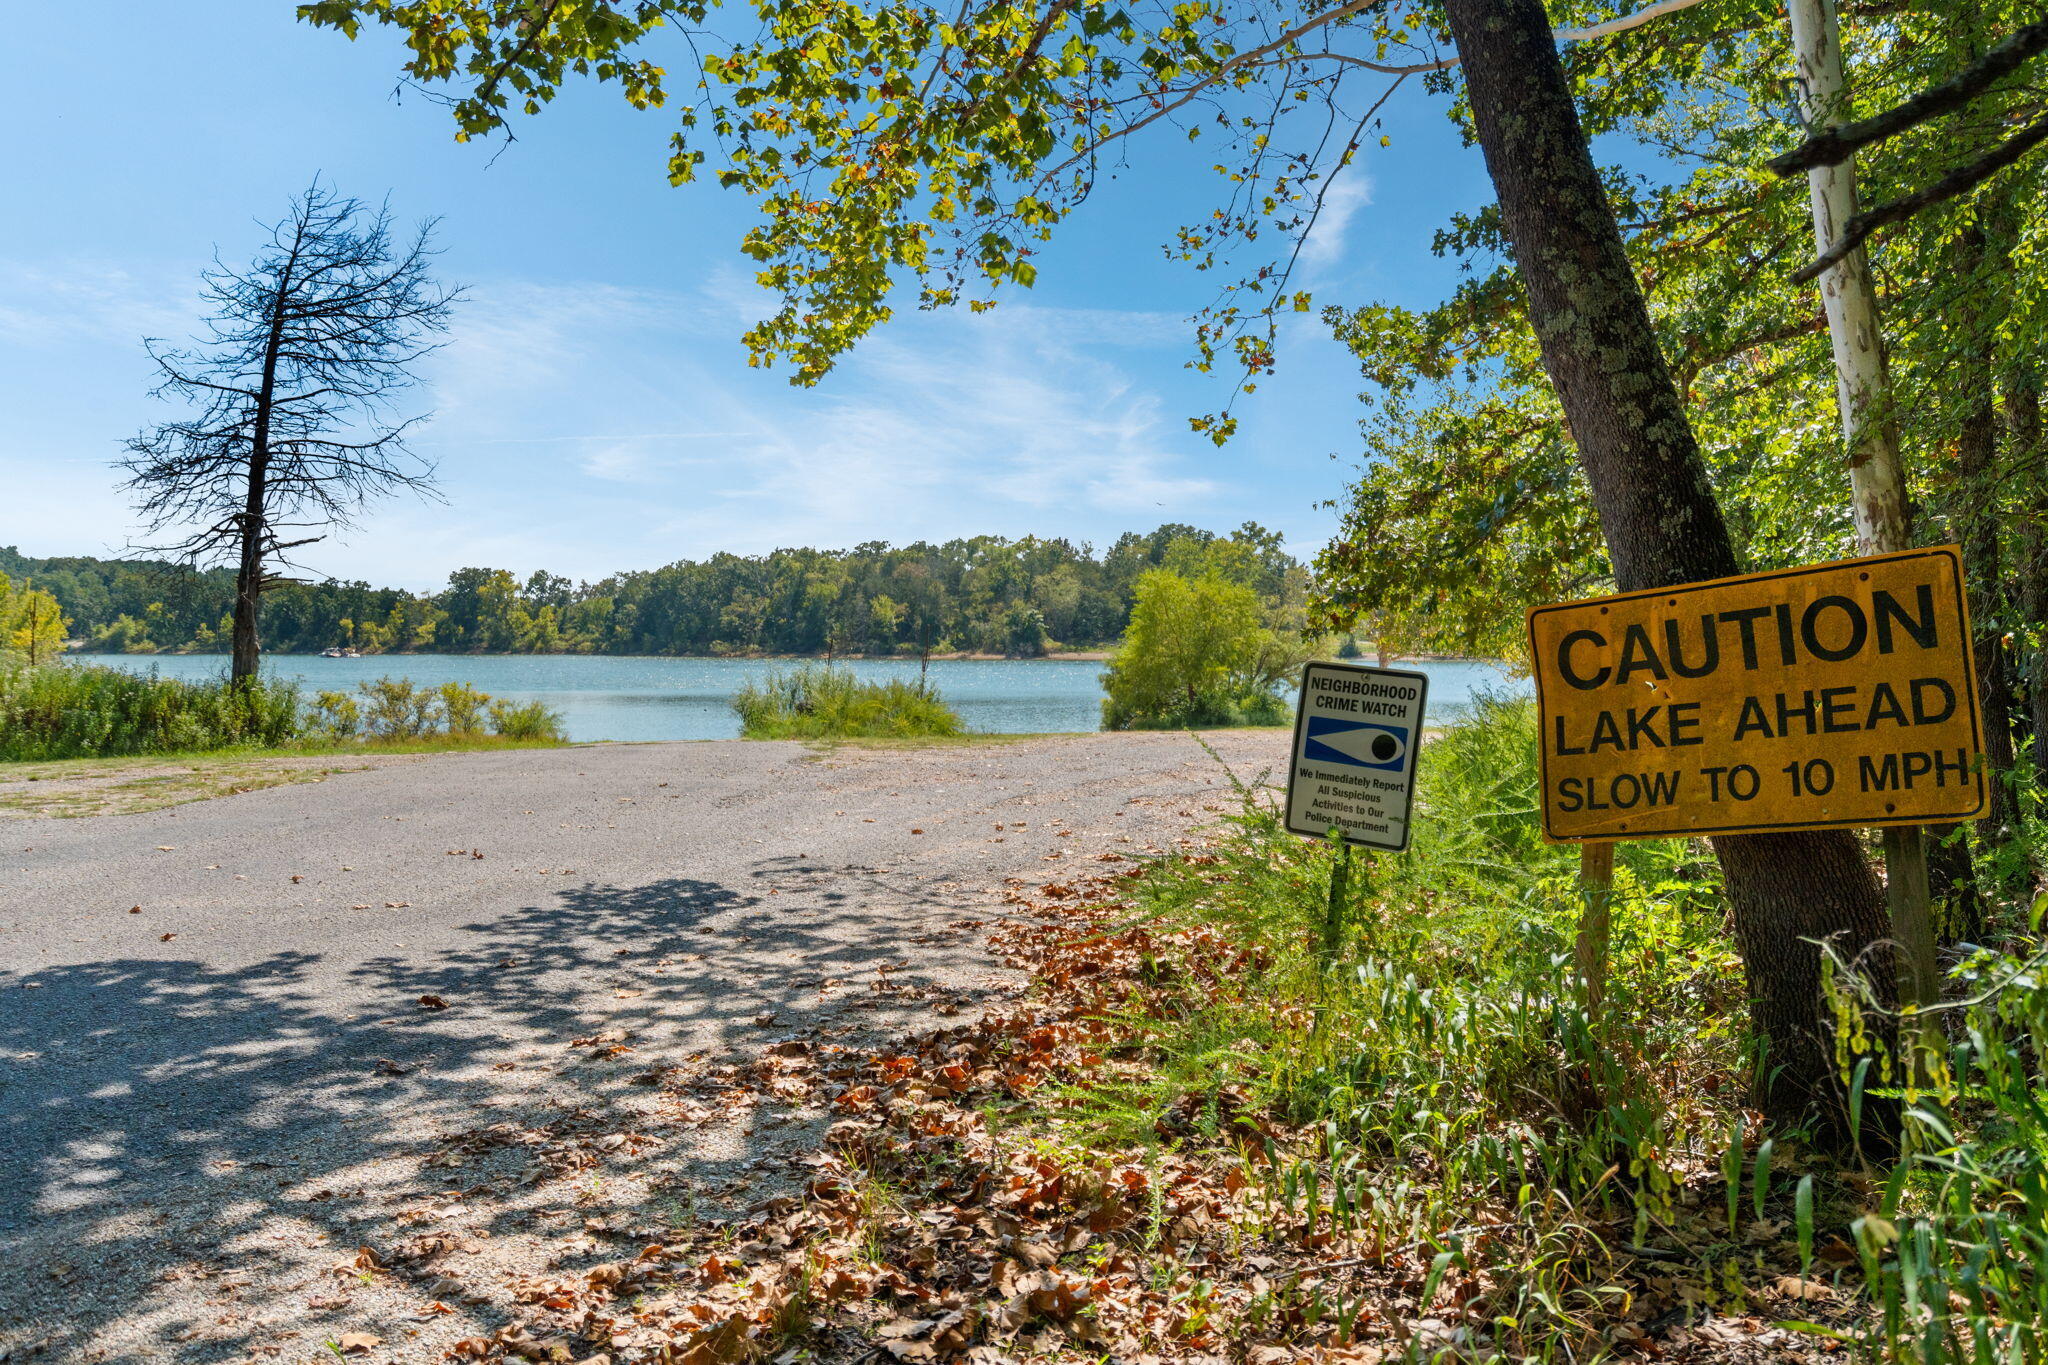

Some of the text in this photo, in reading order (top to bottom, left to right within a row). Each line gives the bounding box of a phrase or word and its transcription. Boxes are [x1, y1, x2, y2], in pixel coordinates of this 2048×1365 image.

[1557, 584, 1939, 691] CAUTION
[1311, 676, 1417, 701] NEIGHBORHOOD
[1315, 695, 1407, 718] CRIME WATCH
[1555, 677, 1957, 756] LAKE AHEAD
[1299, 767, 1405, 795] We Immediately Report
[1557, 747, 1970, 813] SLOW TO 10 MPH
[1317, 785, 1381, 803] All Suspicious
[1311, 798, 1384, 818] Activities to Our
[1305, 811, 1389, 834] Police Department
